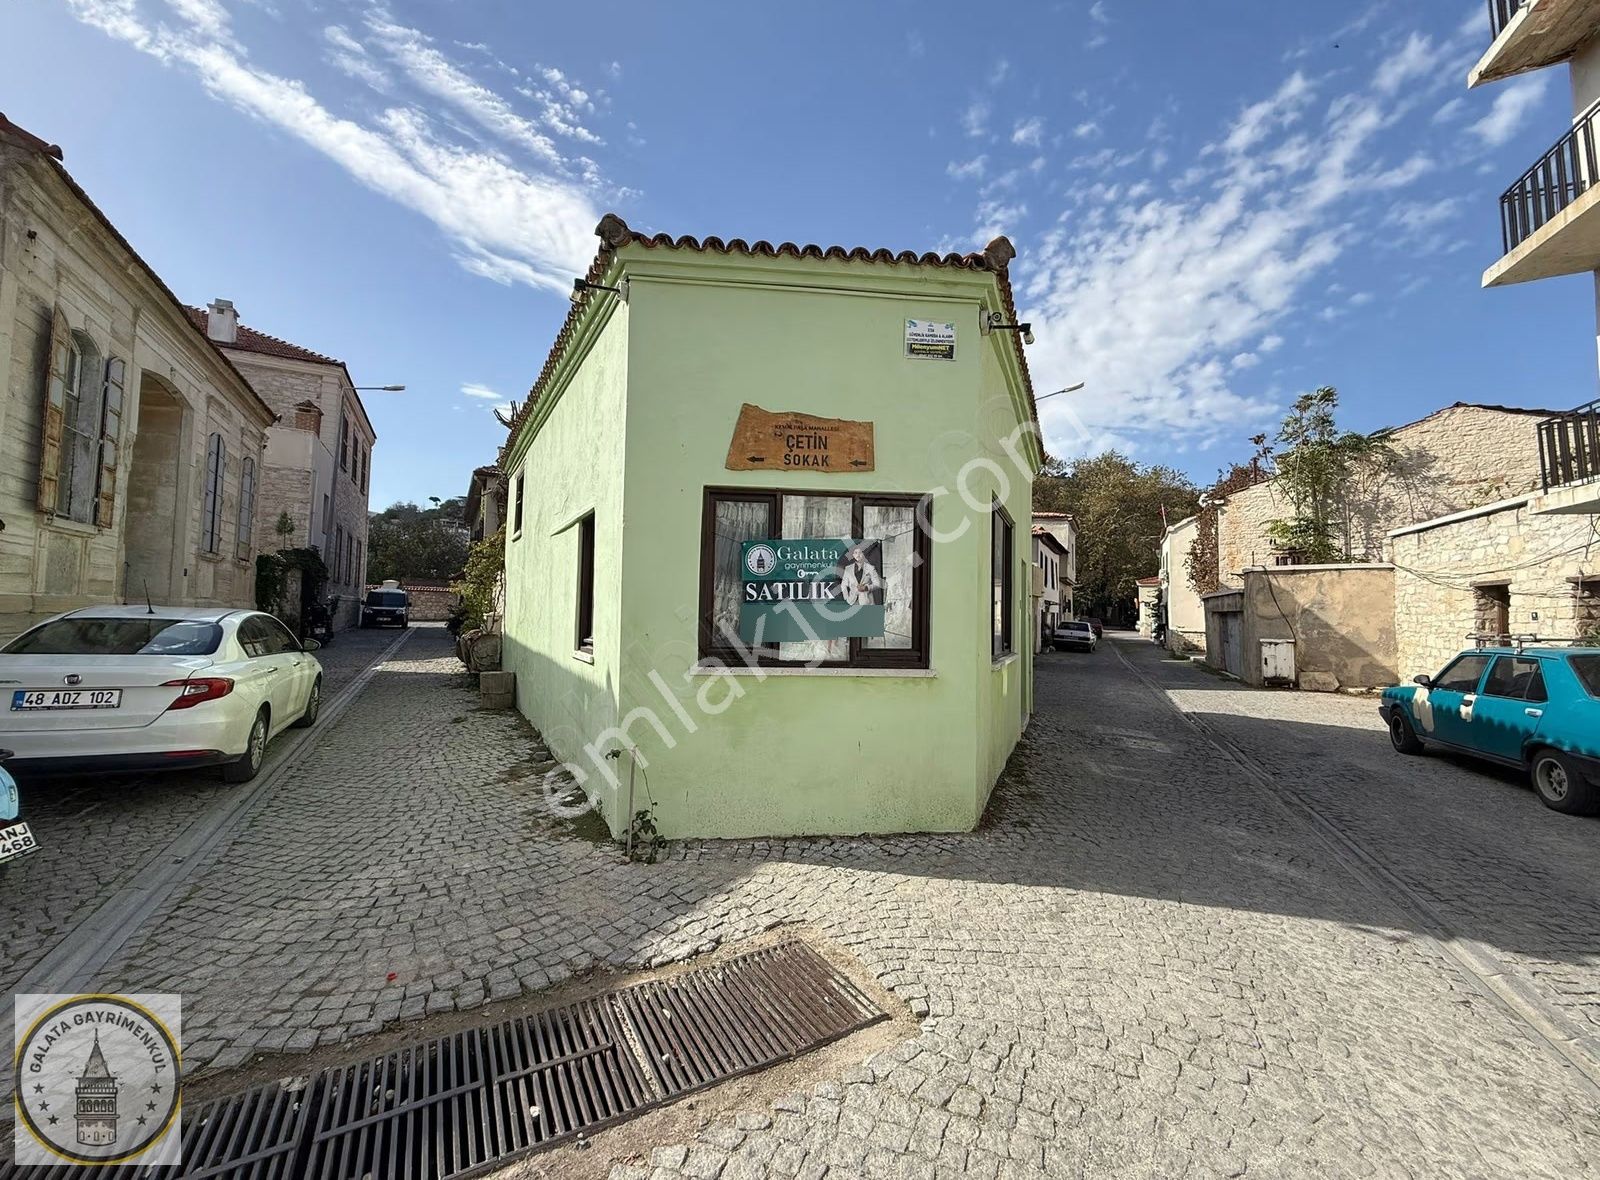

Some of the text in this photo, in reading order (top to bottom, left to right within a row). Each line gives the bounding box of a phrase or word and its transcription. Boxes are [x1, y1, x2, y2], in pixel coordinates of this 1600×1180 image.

[786, 432, 828, 452] ÇETİN
[783, 453, 830, 467] SOKAK
[777, 546, 839, 560] Galata
[784, 561, 833, 571] gayrimenkul
[746, 582, 835, 601] SATILIK
[25, 693, 45, 706] 48
[51, 692, 81, 705] ADZ
[90, 691, 114, 704] 102
[1, 836, 34, 854] 468
